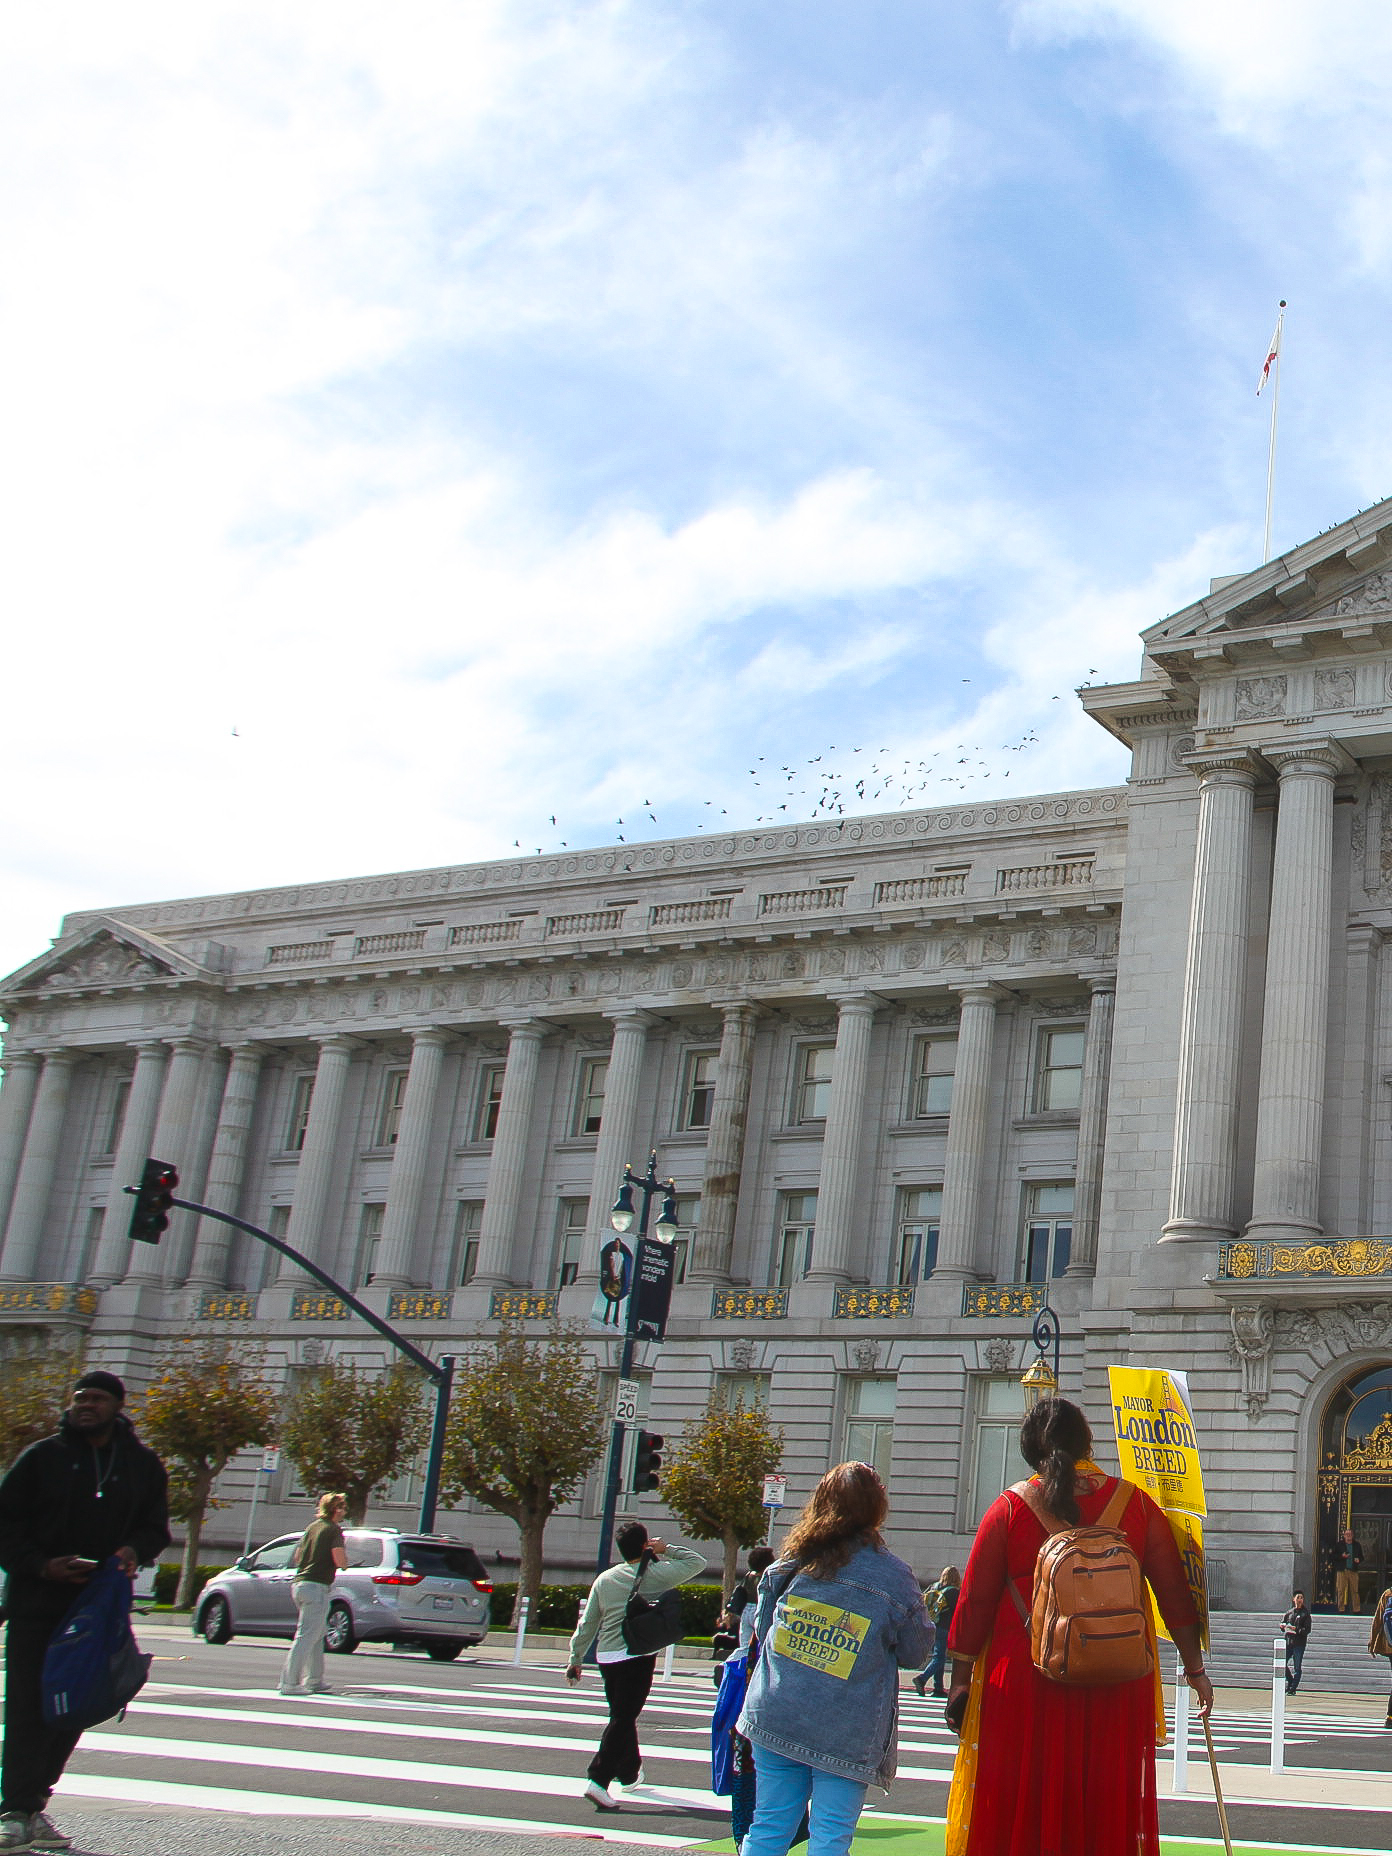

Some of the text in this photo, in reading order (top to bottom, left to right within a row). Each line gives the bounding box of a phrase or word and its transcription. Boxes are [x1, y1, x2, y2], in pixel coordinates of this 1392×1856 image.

[619, 1383, 638, 1393] SPEED
[620, 1392, 636, 1400] LIMIT
[617, 1402, 635, 1419] 20
[1122, 1395, 1155, 1413] MAYOR
[1114, 1405, 1197, 1450] London
[1132, 1445, 1187, 1476] BREED
[792, 1608, 828, 1626] MAYOR
[786, 1634, 841, 1662] BREED
